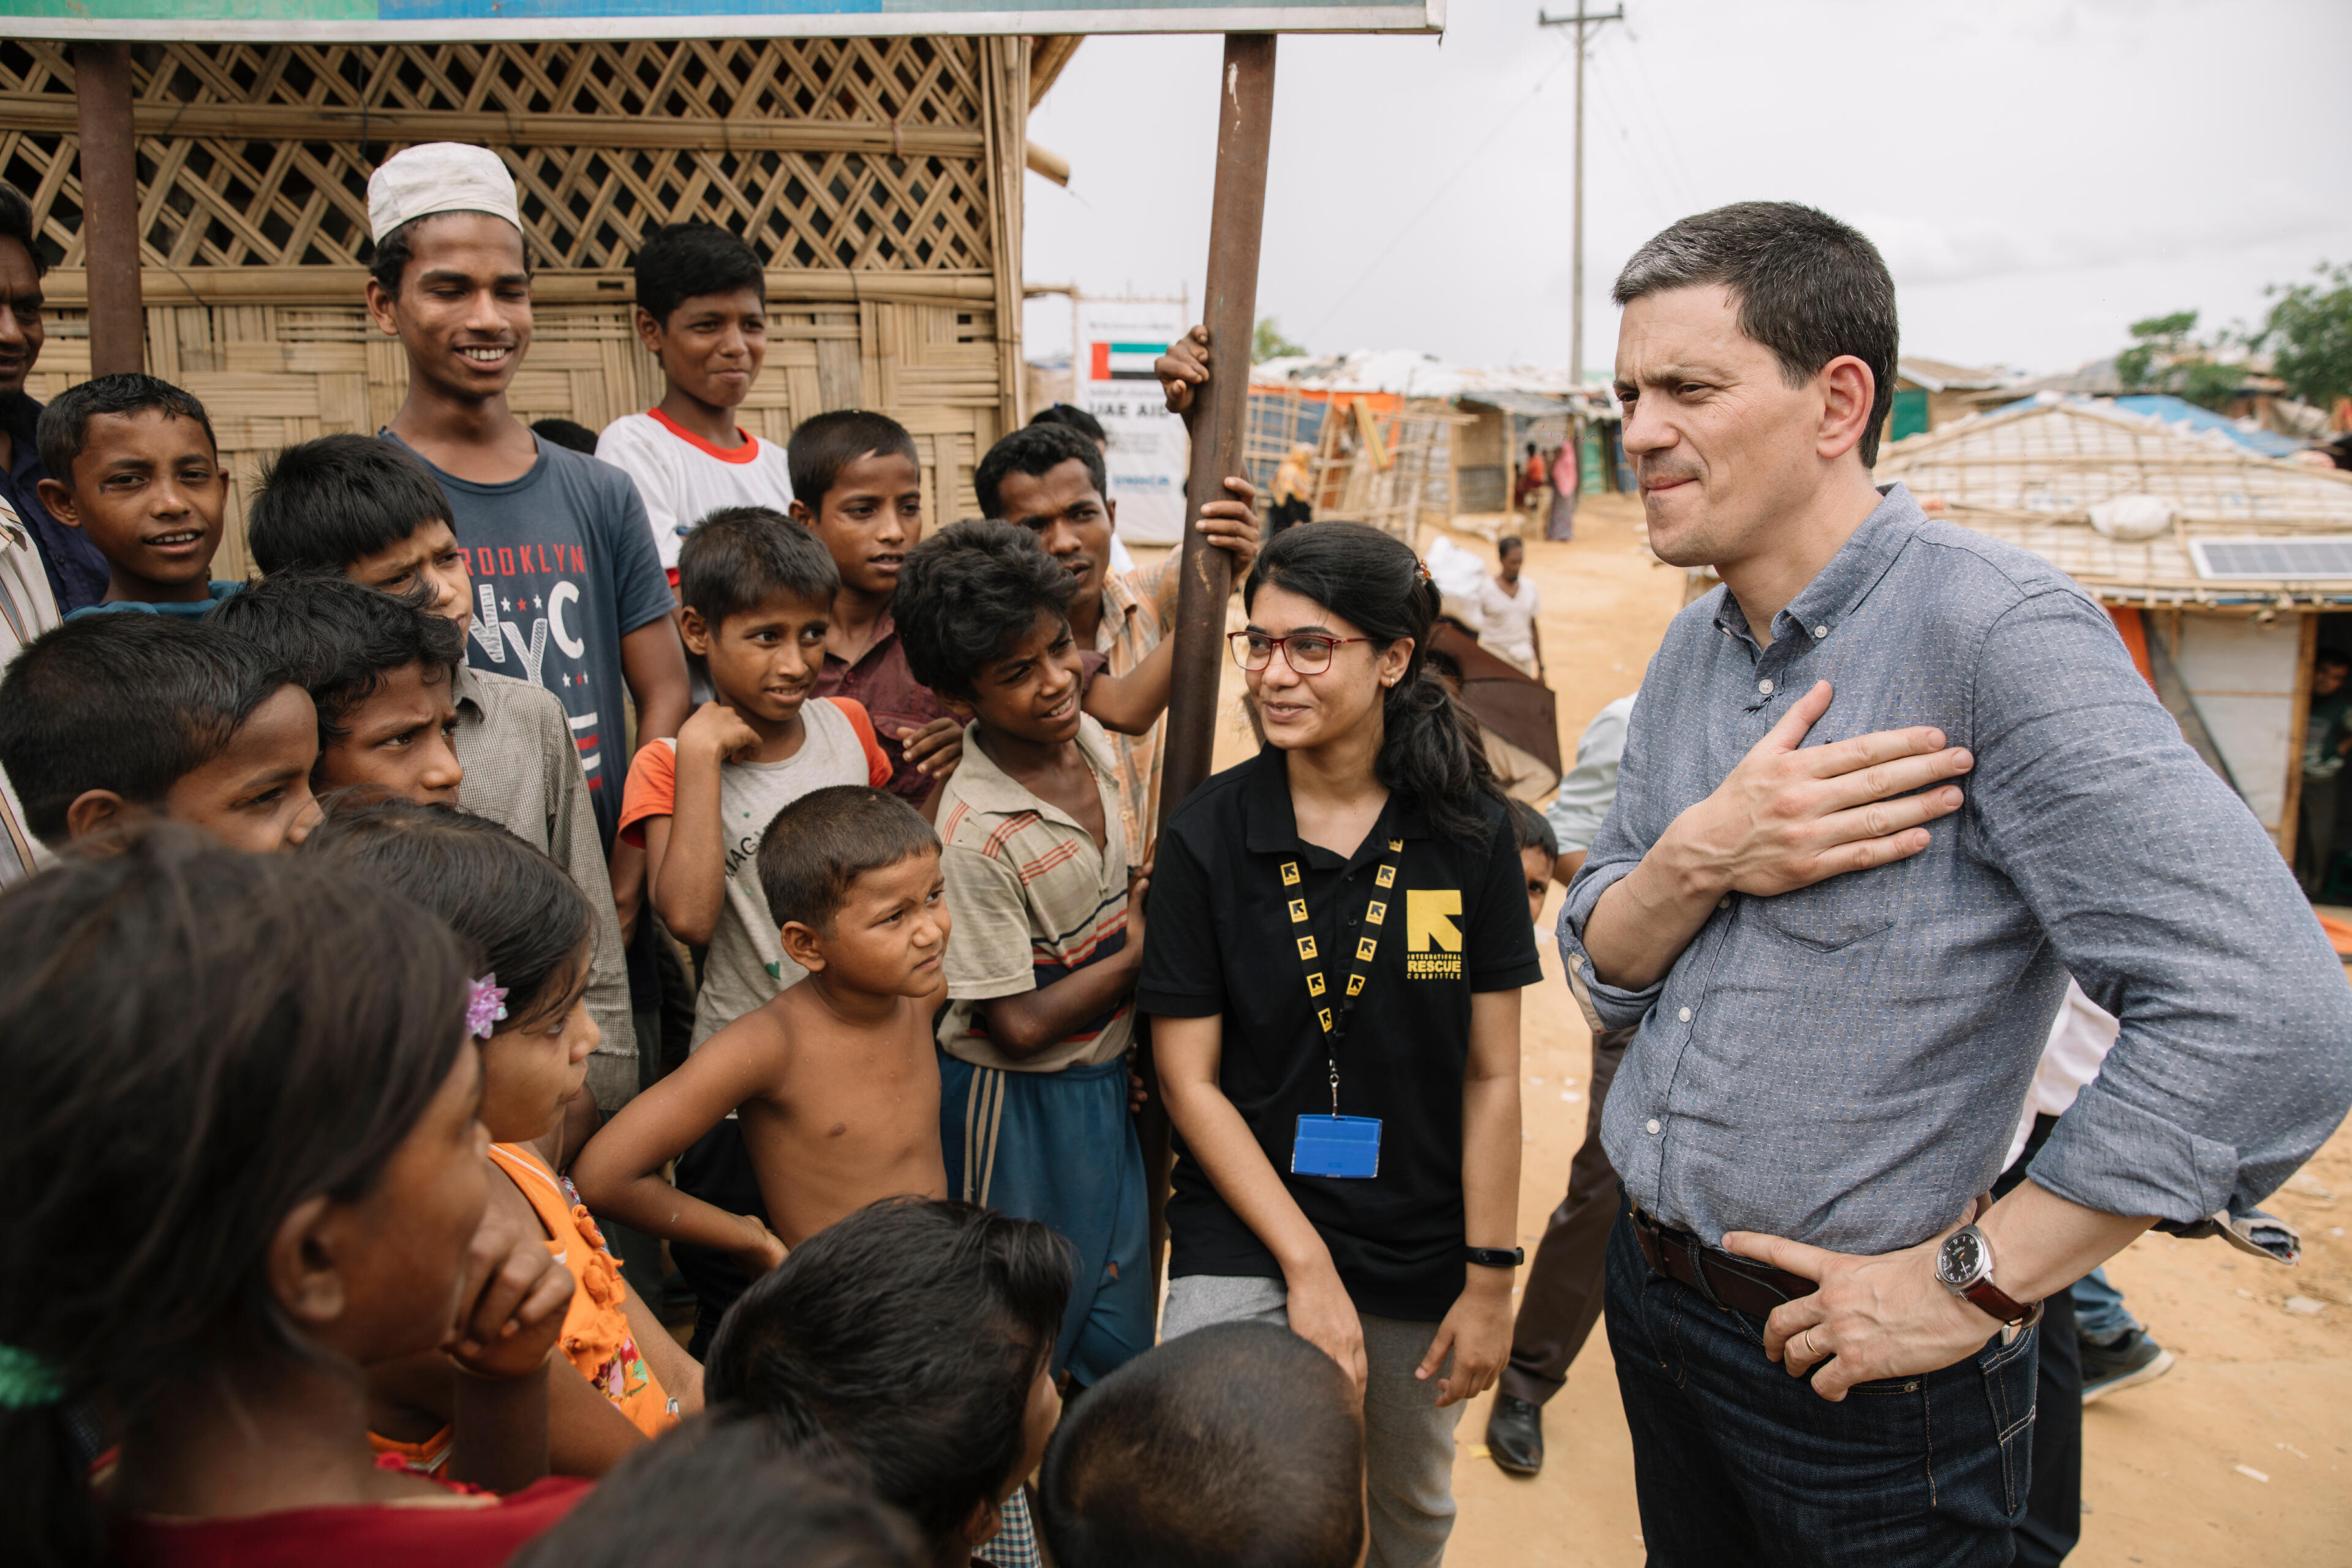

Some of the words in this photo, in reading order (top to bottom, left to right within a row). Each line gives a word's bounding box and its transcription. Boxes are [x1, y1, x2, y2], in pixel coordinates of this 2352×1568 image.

[1089, 403, 1128, 418] UAE
[1136, 403, 1170, 418] AID
[457, 543, 586, 576] ROOKLYN
[463, 580, 585, 687] NYC
[725, 831, 761, 881] MAG
[1408, 960, 1461, 973] RESCUE
